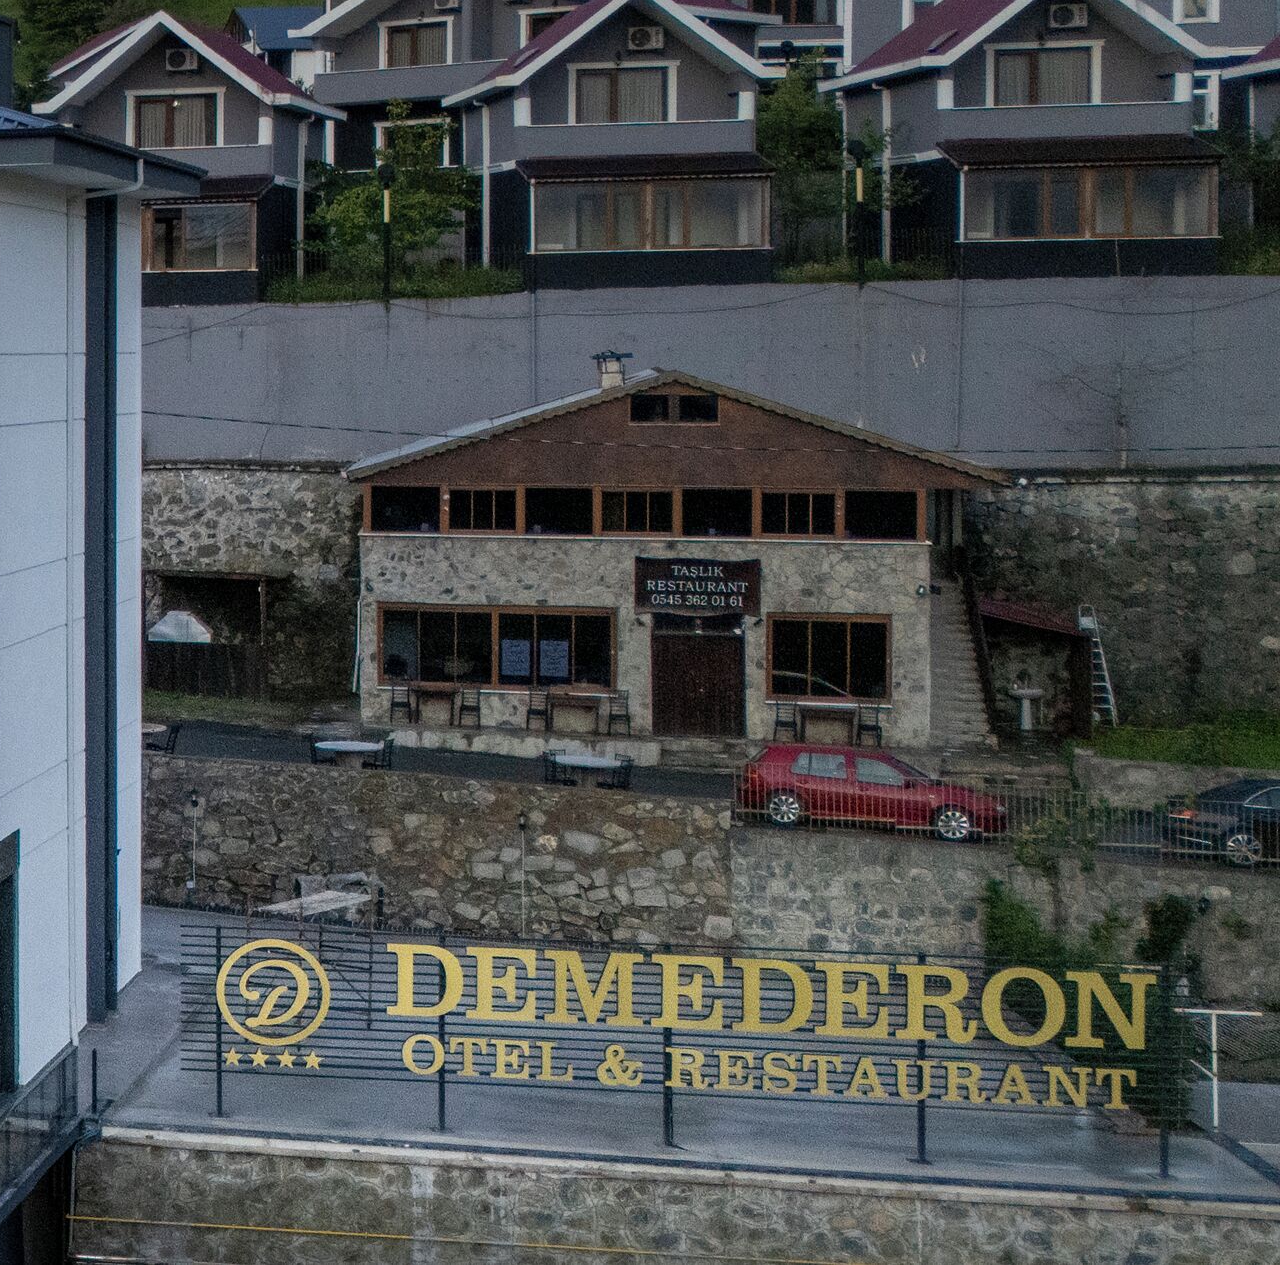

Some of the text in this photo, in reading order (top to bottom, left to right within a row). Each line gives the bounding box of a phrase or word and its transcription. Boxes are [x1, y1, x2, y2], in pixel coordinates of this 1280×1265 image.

[671, 565, 724, 578] TAŞLIK
[646, 580, 749, 593] RESTAURANT
[651, 594, 744, 607] 0545 362 01 61
[386, 943, 1157, 1050] DEMEDERON
[402, 1034, 1138, 1110] OTEL & RESTAURANT
